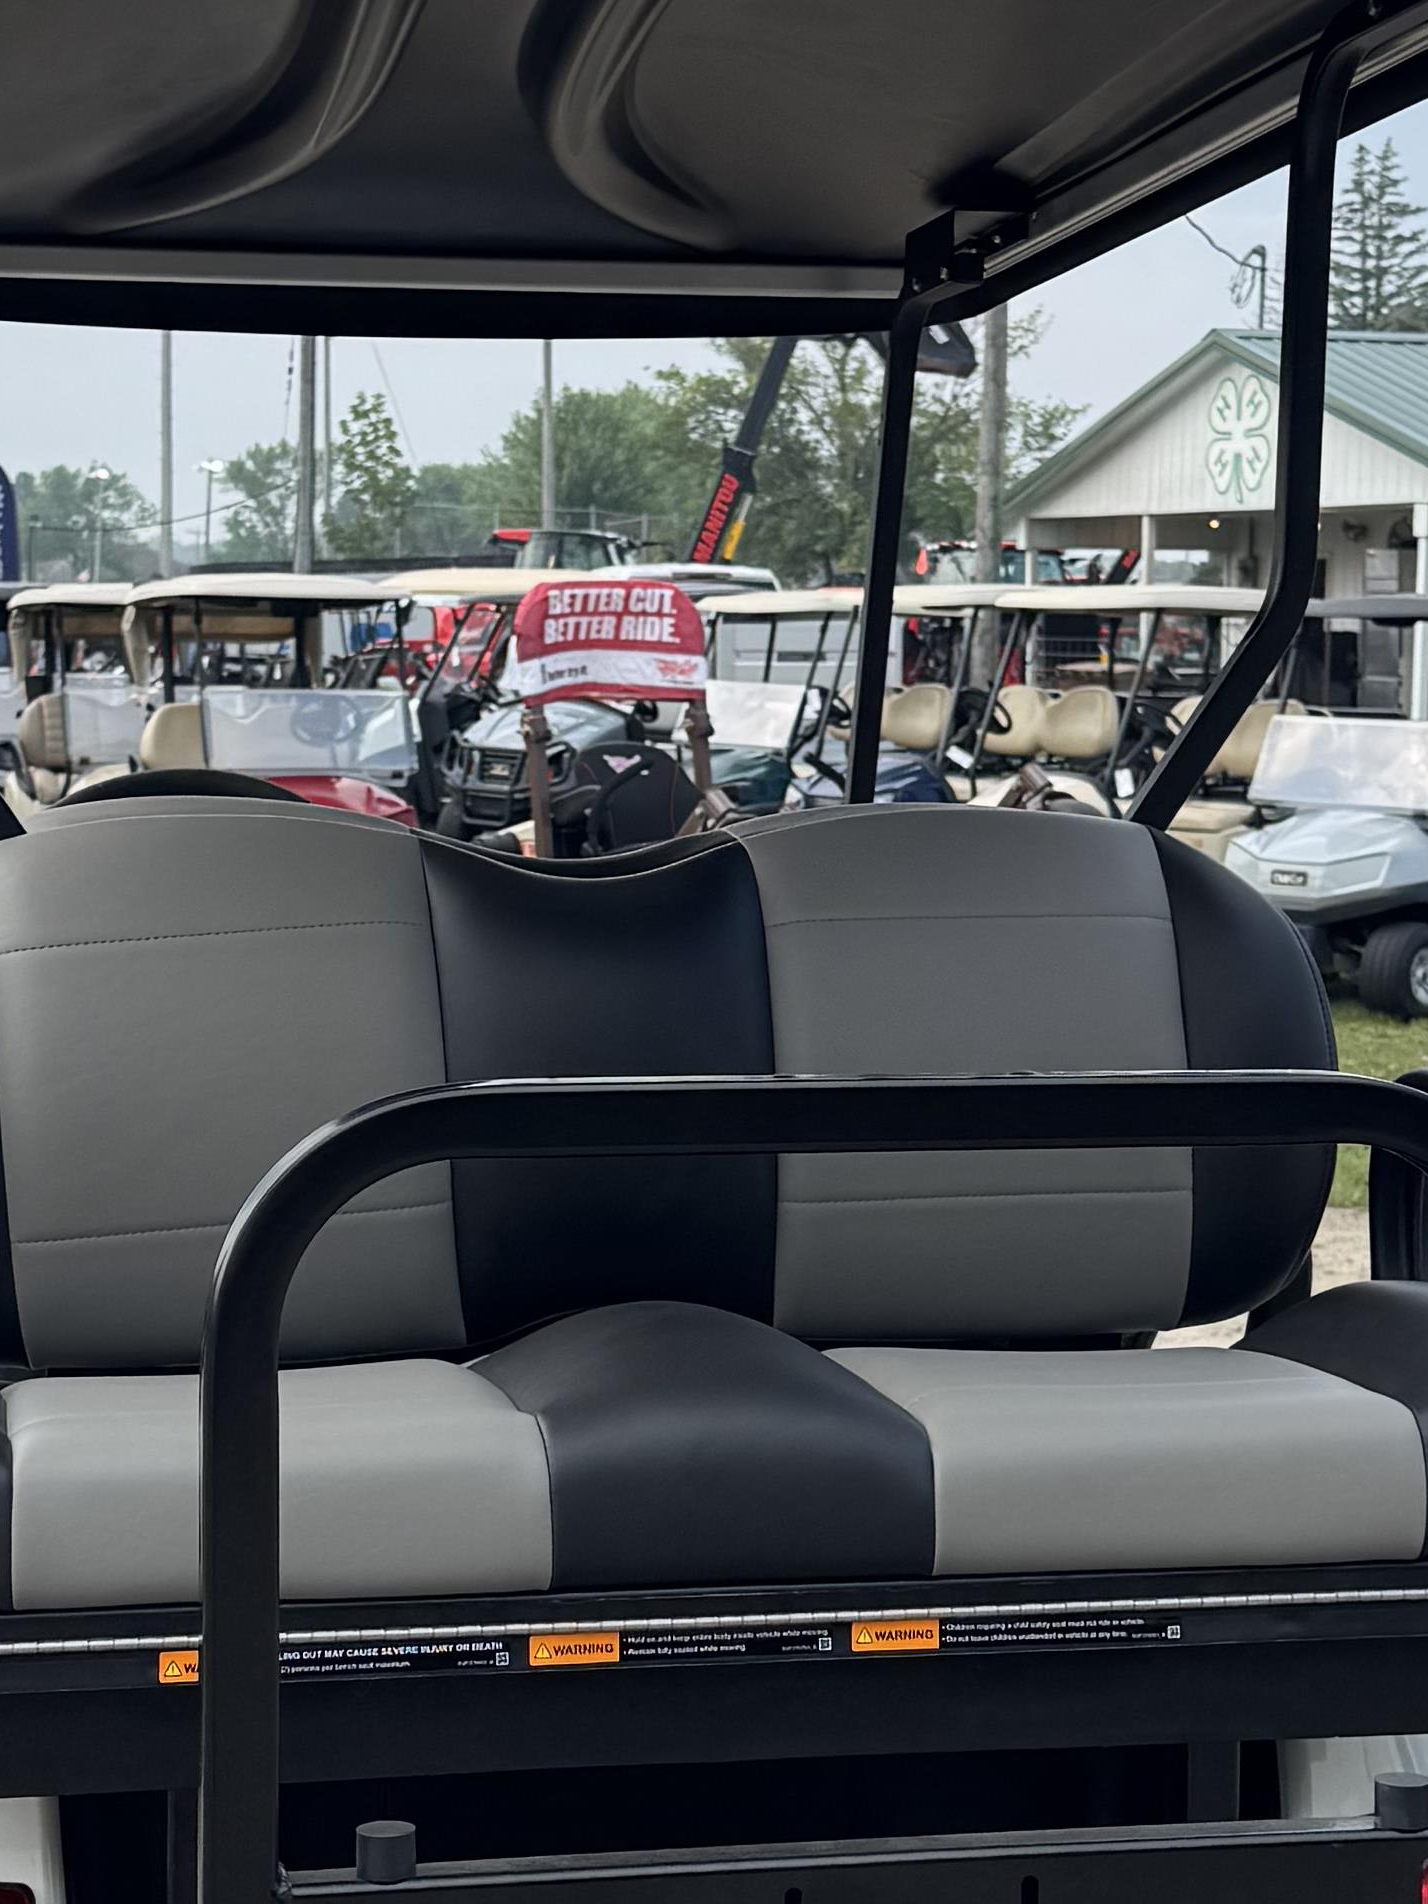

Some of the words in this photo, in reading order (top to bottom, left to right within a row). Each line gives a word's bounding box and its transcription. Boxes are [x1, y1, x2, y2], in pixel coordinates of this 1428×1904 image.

[692, 473, 740, 564] MANITOU
[547, 588, 627, 616] BETTER
[628, 588, 678, 614] CUT.
[544, 615, 617, 644] BETTER
[619, 616, 681, 644] RIDE.
[874, 1629, 934, 1642] WARNING
[302, 1650, 322, 1659] OUT
[324, 1649, 344, 1658] MAY
[346, 1647, 379, 1657] CAUSE
[381, 1645, 419, 1655] SEVERE
[455, 1642, 470, 1651] OR
[471, 1641, 503, 1650] DEATH
[553, 1643, 614, 1657] WARNING
